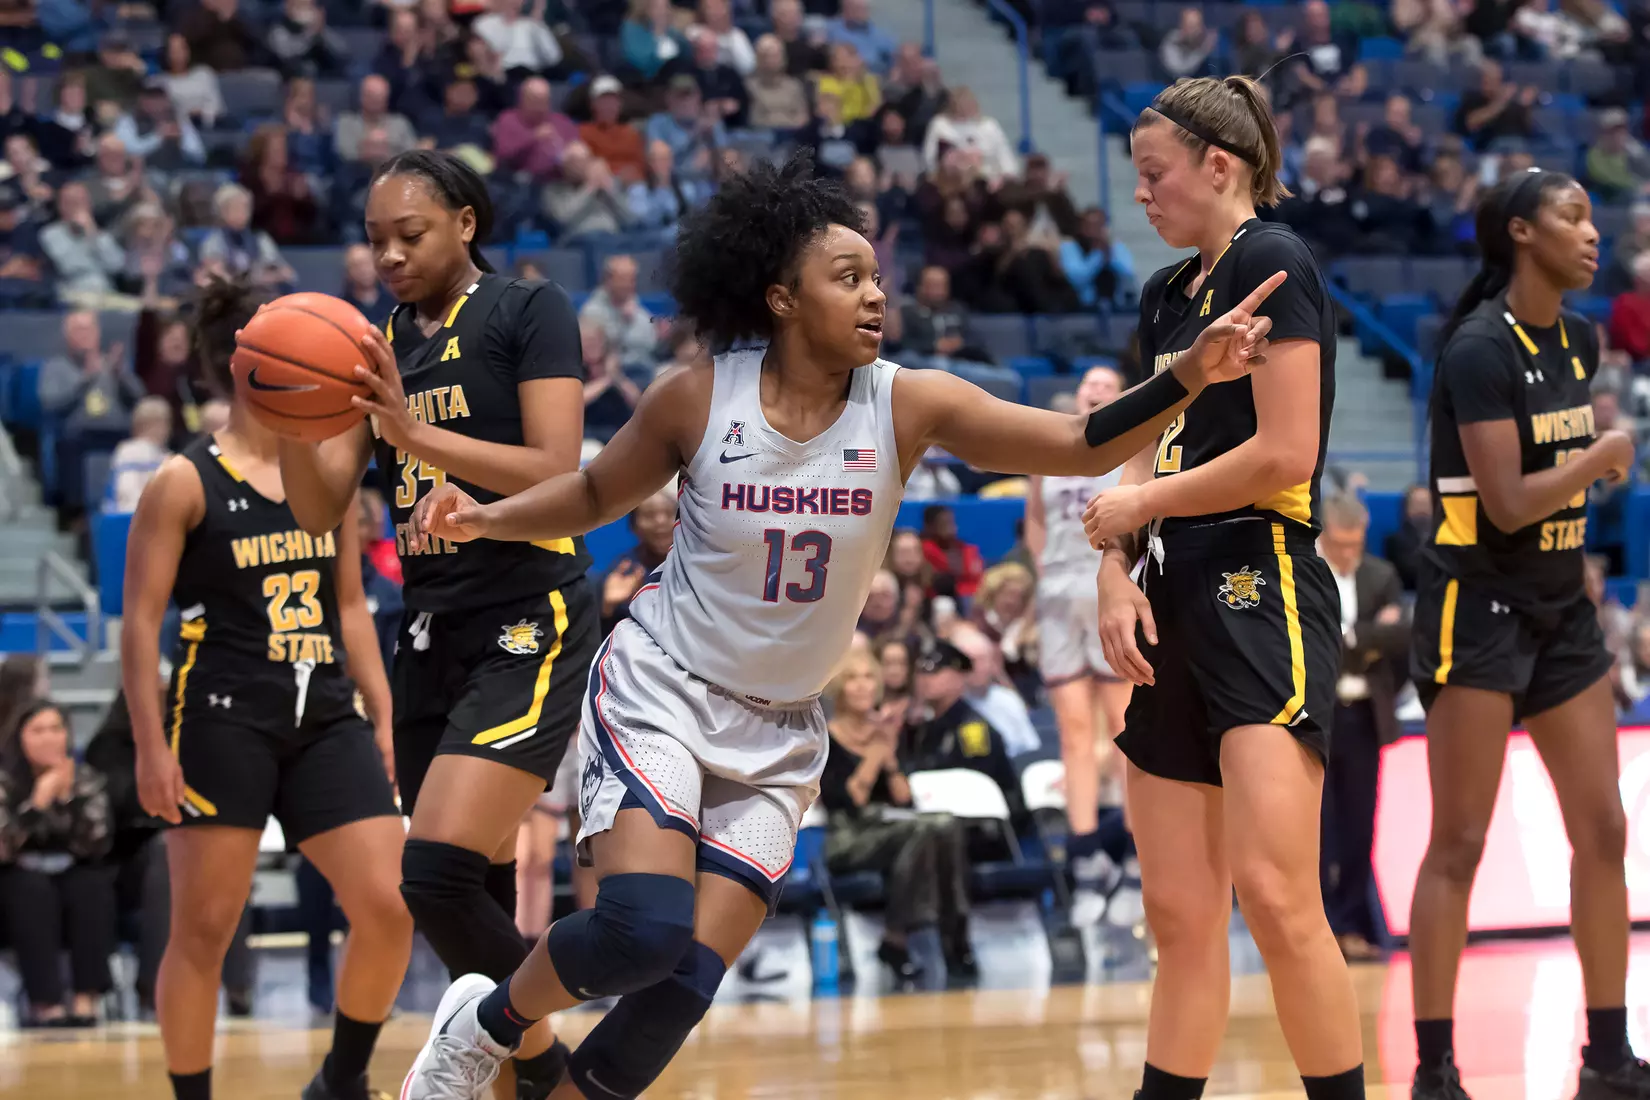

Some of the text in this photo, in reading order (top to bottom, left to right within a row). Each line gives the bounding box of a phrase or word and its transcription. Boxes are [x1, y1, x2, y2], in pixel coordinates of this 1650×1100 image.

[440, 335, 461, 362] A
[404, 384, 471, 425] HITA
[1531, 404, 1597, 444] WICHIT
[1154, 410, 1186, 473] 2
[721, 482, 873, 516] HUSKIES
[1539, 516, 1588, 552] STAT
[762, 528, 833, 604] 13
[262, 569, 324, 633] 23
[267, 632, 335, 665] STATE
